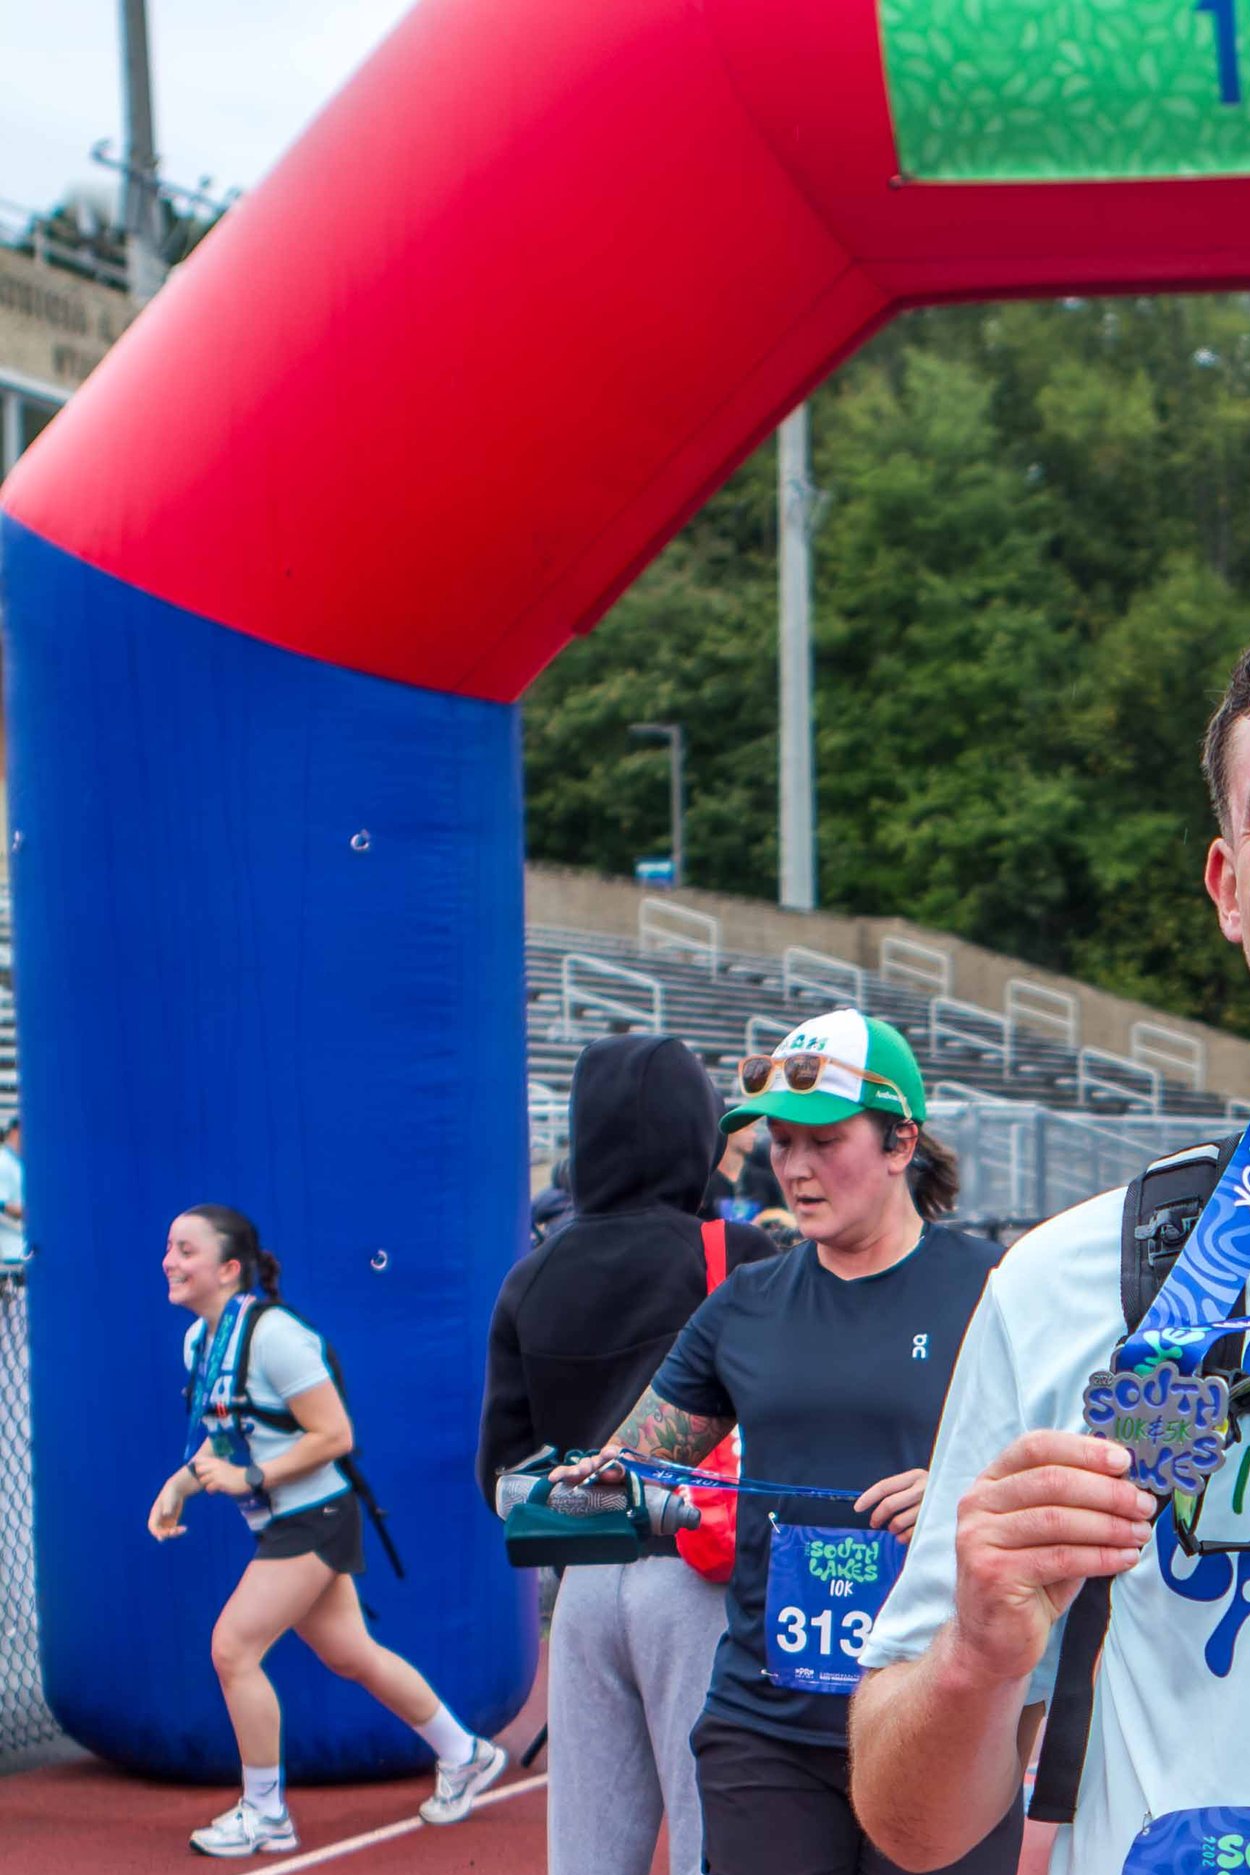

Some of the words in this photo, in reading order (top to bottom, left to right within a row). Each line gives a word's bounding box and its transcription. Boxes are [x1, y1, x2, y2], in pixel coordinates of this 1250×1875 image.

[1088, 1367, 1221, 1429] SOUTH
[810, 1537, 880, 1564] SOUTH
[809, 1557, 878, 1583] LAKES
[829, 1579, 854, 1597] 10K
[776, 1606, 873, 1658] 313
